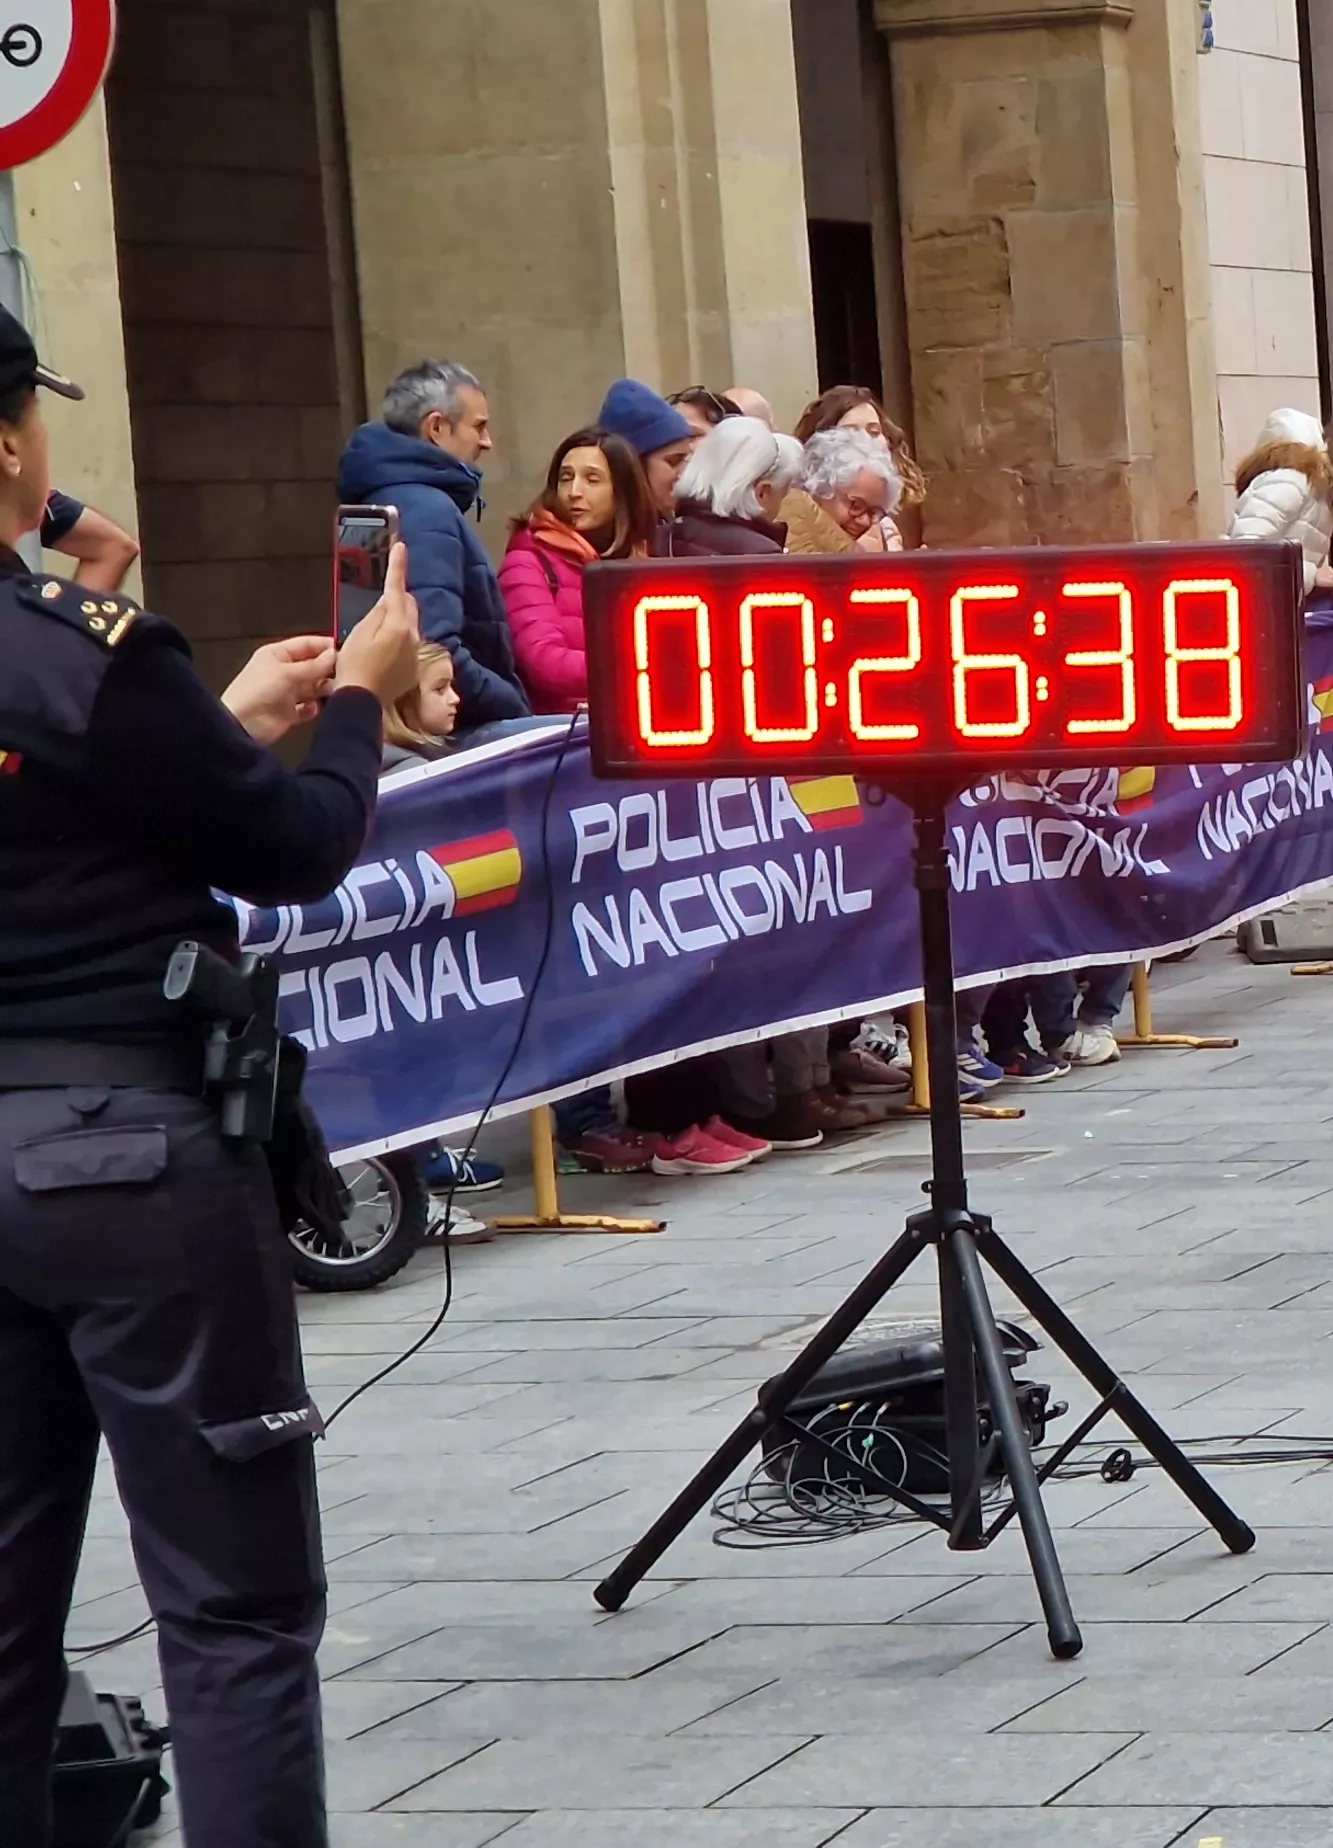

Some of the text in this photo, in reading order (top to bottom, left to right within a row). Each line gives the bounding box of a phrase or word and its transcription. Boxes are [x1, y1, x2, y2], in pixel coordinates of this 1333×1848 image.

[633, 578, 1243, 747] 00:26:38
[236, 850, 456, 953] OLICÍA
[571, 845, 872, 977] NACIONAL
[277, 930, 525, 1051] CIONAL
